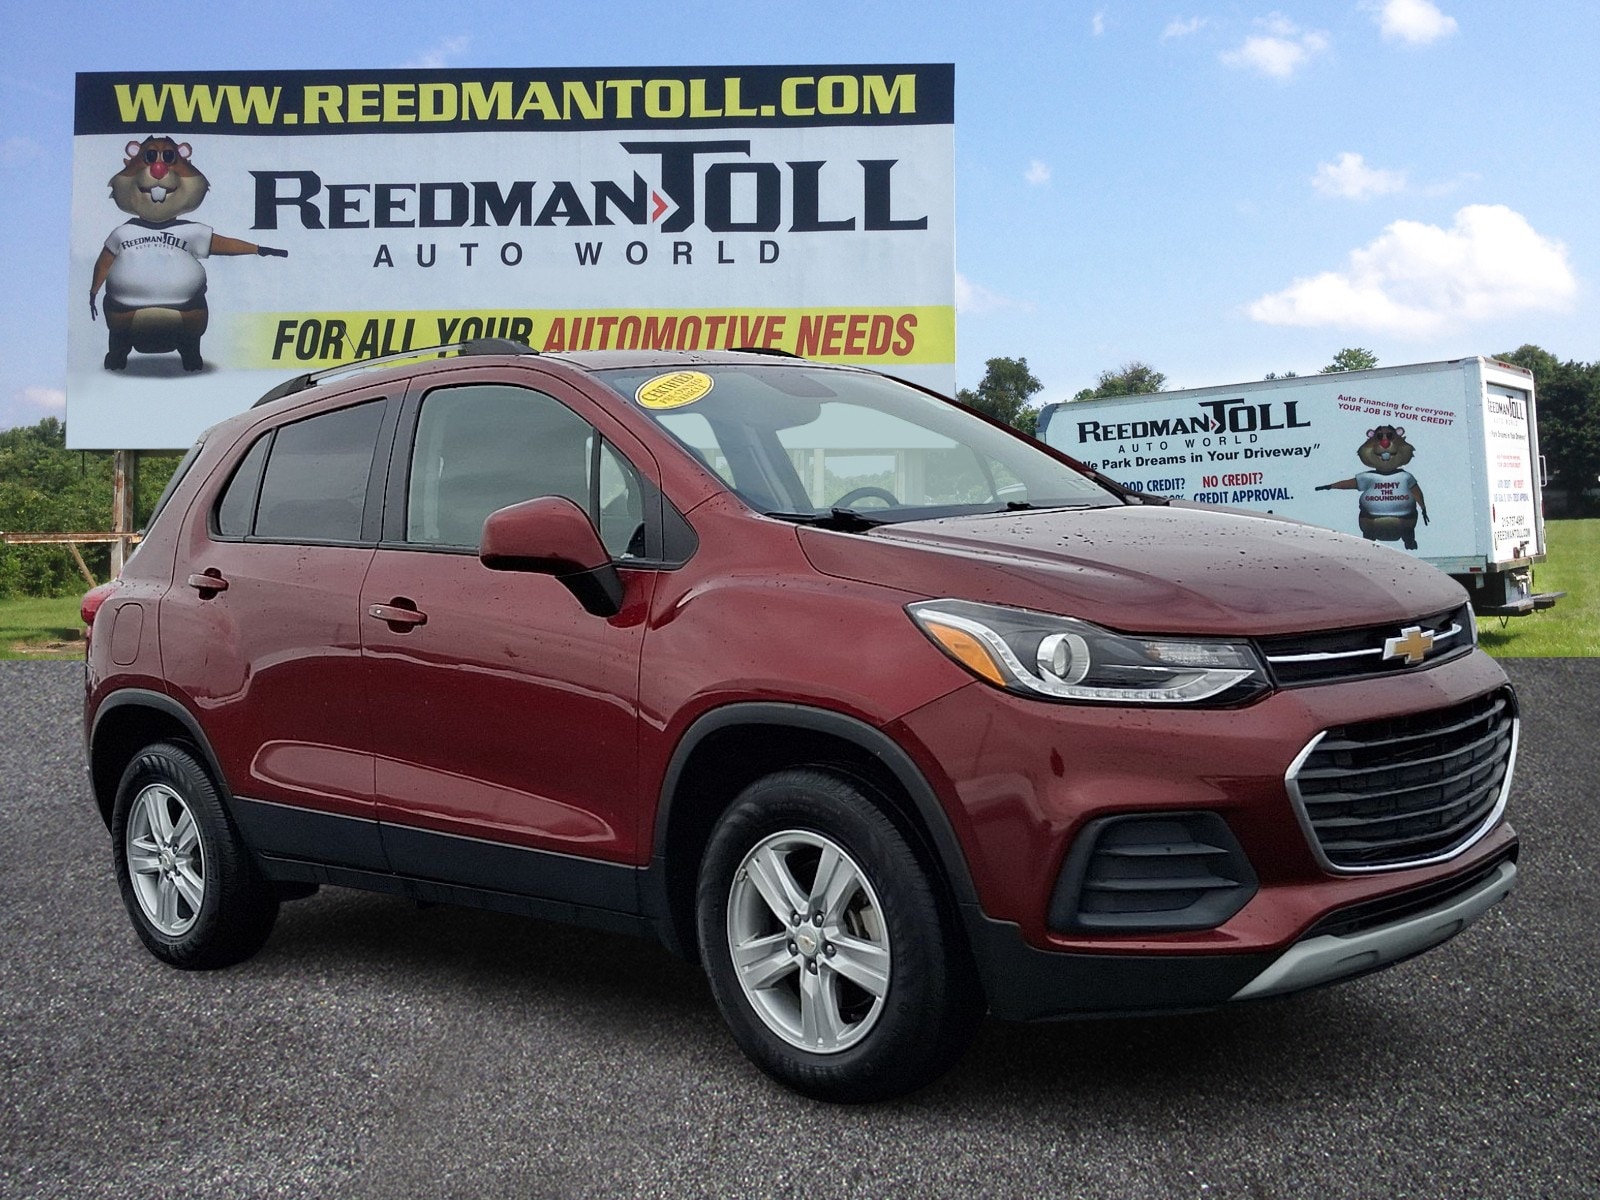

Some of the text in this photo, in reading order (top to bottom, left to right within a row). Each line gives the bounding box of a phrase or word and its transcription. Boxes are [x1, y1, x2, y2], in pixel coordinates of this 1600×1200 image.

[114, 74, 916, 125] WWW.REEDMANTOLL.COM
[373, 240, 781, 268] AUTO WORLD
[272, 319, 347, 360] FOR
[354, 318, 416, 359] ALL
[542, 315, 786, 352] AUTOMOTIVE
[796, 313, 918, 358] NEEDS
[642, 373, 694, 401] CERTIFIED
[1337, 394, 1457, 418] Auto Financing for everyone.
[1338, 403, 1361, 412] YOUR
[1363, 406, 1381, 415] JOB
[1394, 411, 1419, 421] YOUR
[1420, 415, 1454, 426] CREDIT
[1118, 433, 1258, 454] AUTO WORLD
[1102, 457, 1132, 470] Park
[1135, 455, 1186, 467] Dreams
[1190, 452, 1203, 463] in
[1207, 449, 1240, 462] Your
[1146, 477, 1185, 492] CREDIT?
[1202, 472, 1263, 488] NO CREDIT?
[1374, 482, 1400, 490] JIMMY
[1193, 491, 1229, 504] CREDIT
[1232, 487, 1294, 503] APPROVAL.
